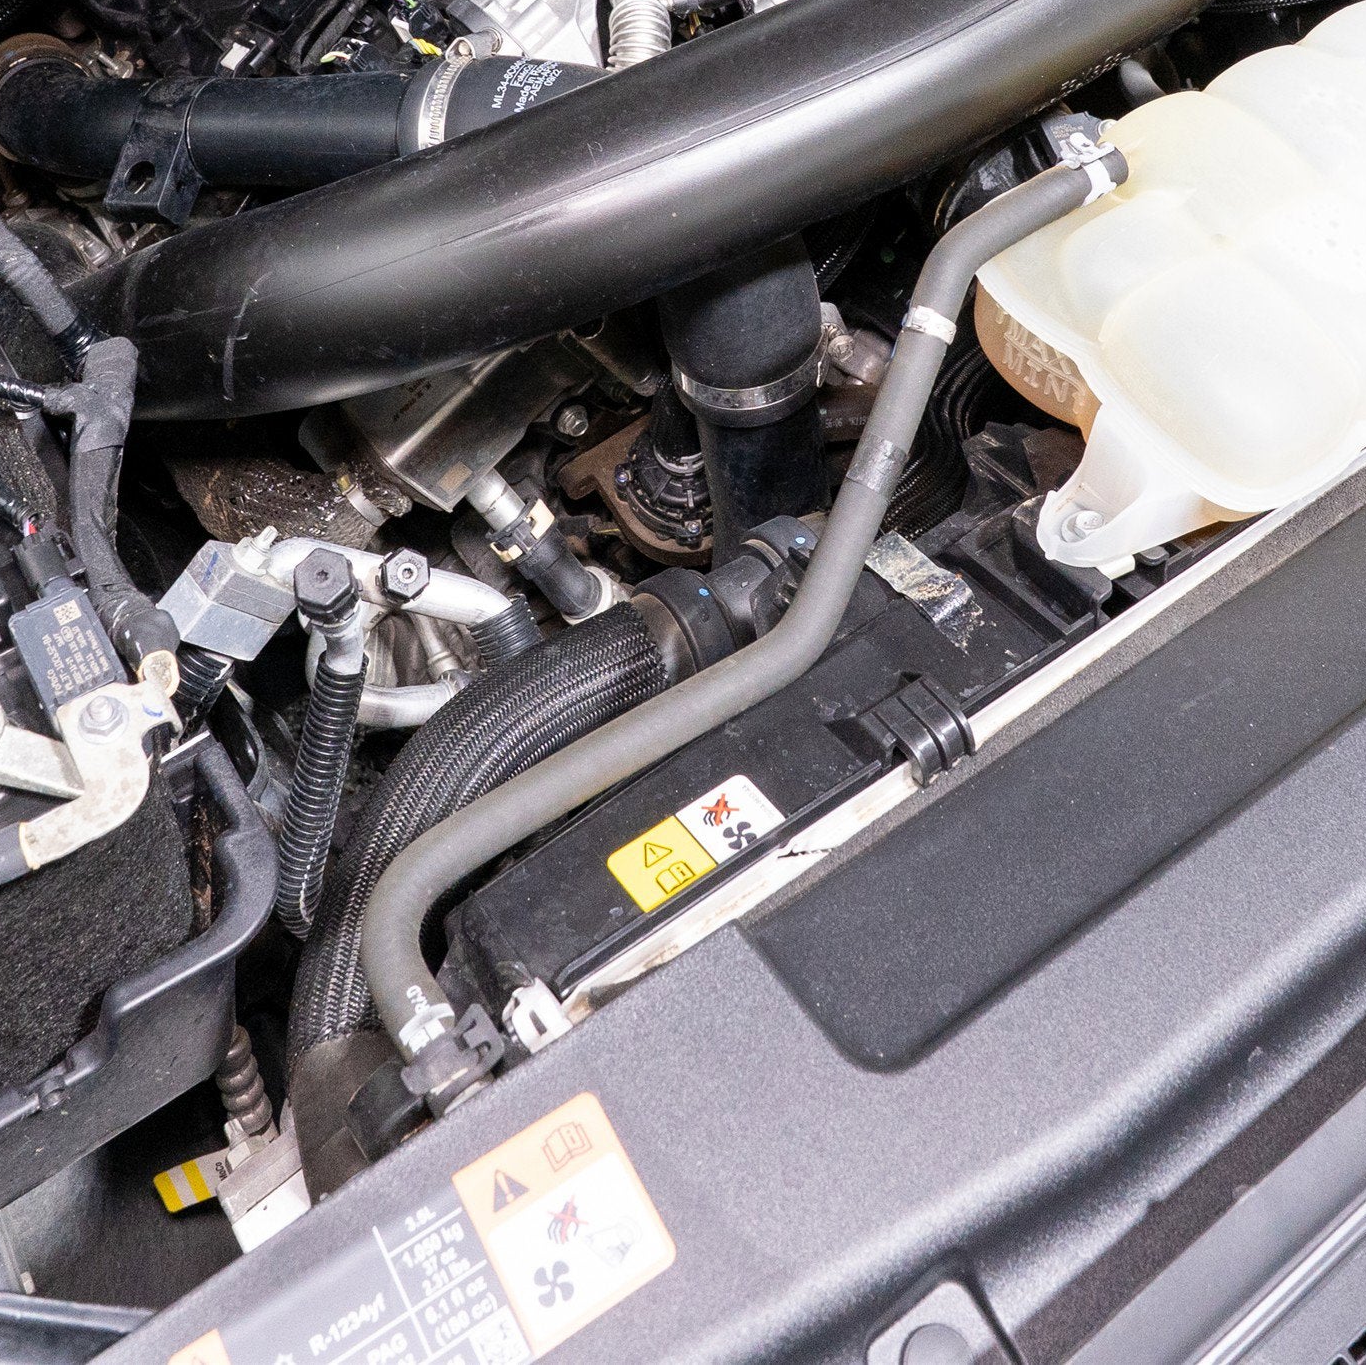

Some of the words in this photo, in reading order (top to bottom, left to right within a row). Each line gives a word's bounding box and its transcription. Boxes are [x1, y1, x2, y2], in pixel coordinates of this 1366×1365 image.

[514, 85, 531, 113] Made
[1002, 343, 1070, 403] MIN
[441, 1221, 465, 1244] kg
[308, 1291, 386, 1357] R-1234yf
[367, 1333, 408, 1365] PAG
